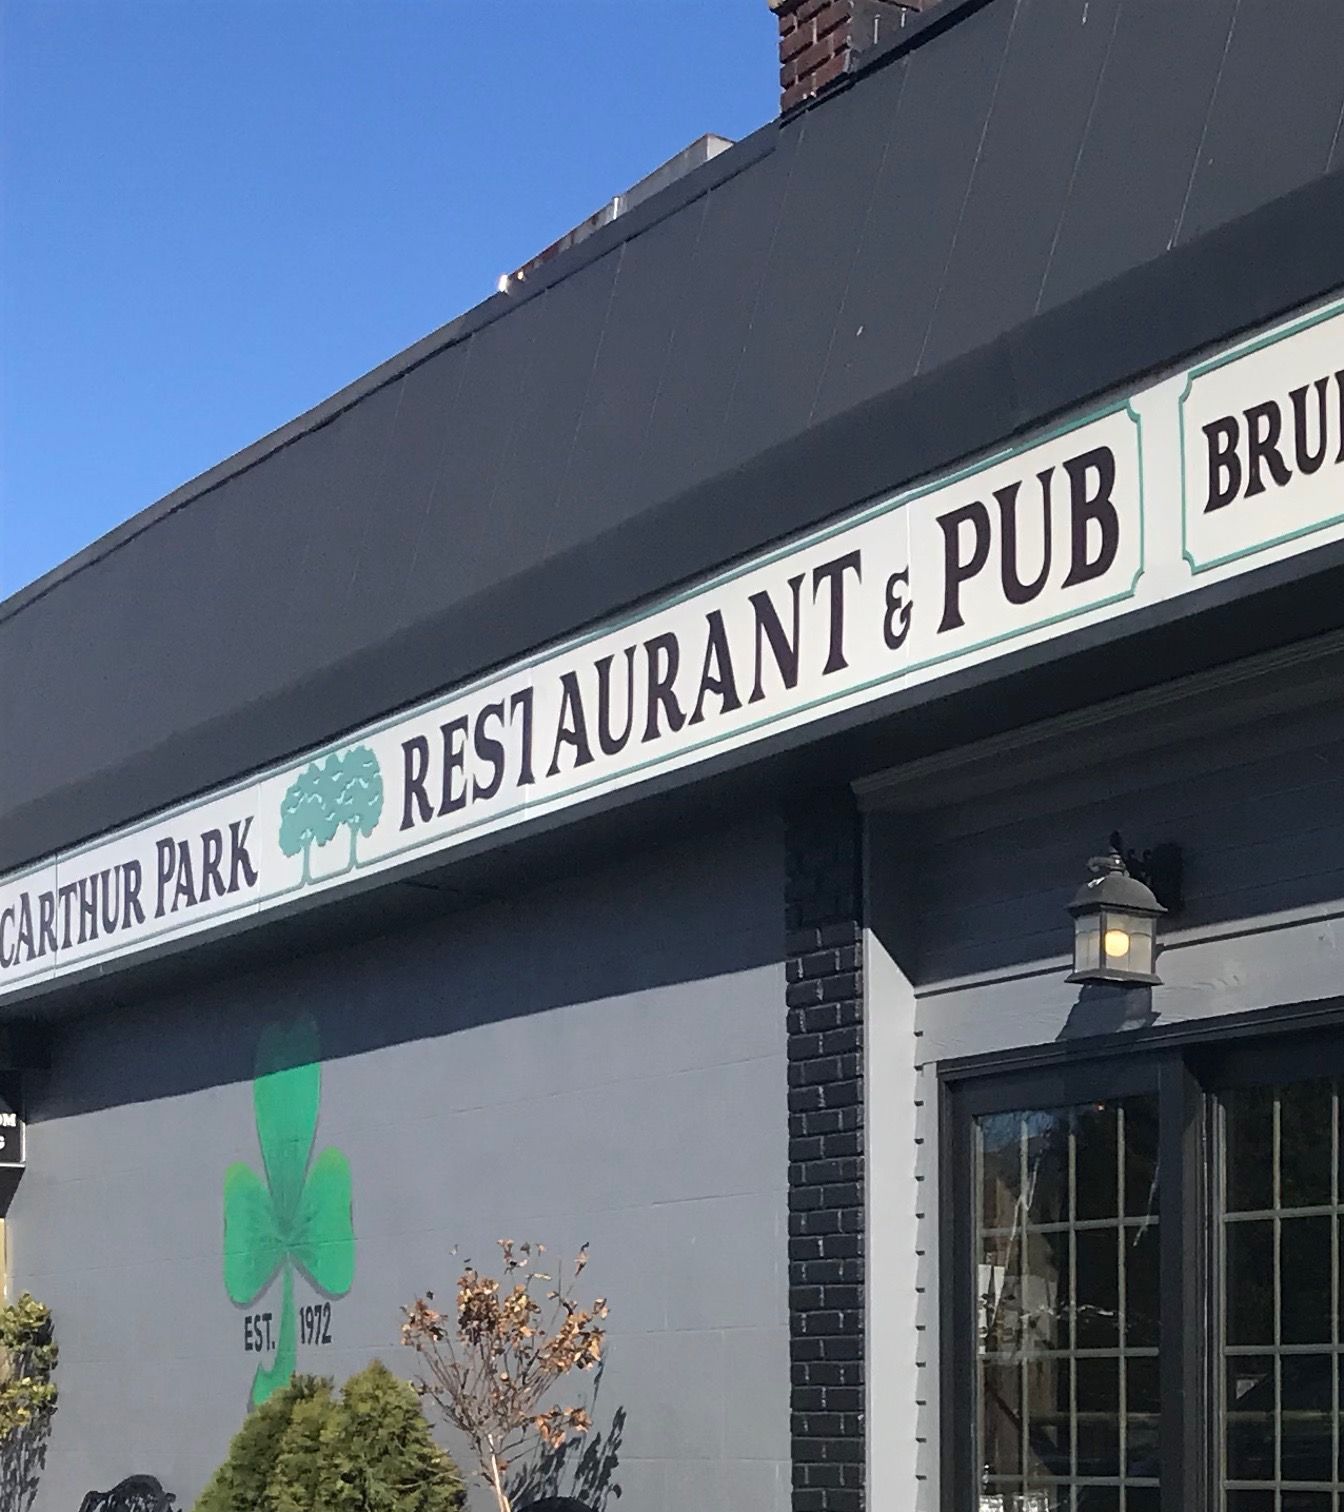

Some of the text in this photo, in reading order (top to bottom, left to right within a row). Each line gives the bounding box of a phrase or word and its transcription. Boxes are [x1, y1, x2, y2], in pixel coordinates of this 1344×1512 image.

[400, 446, 1119, 831] RESTAURANT & PUB
[0, 816, 259, 968] CARTHUR PARK
[245, 1302, 332, 1352] EST. 1972
